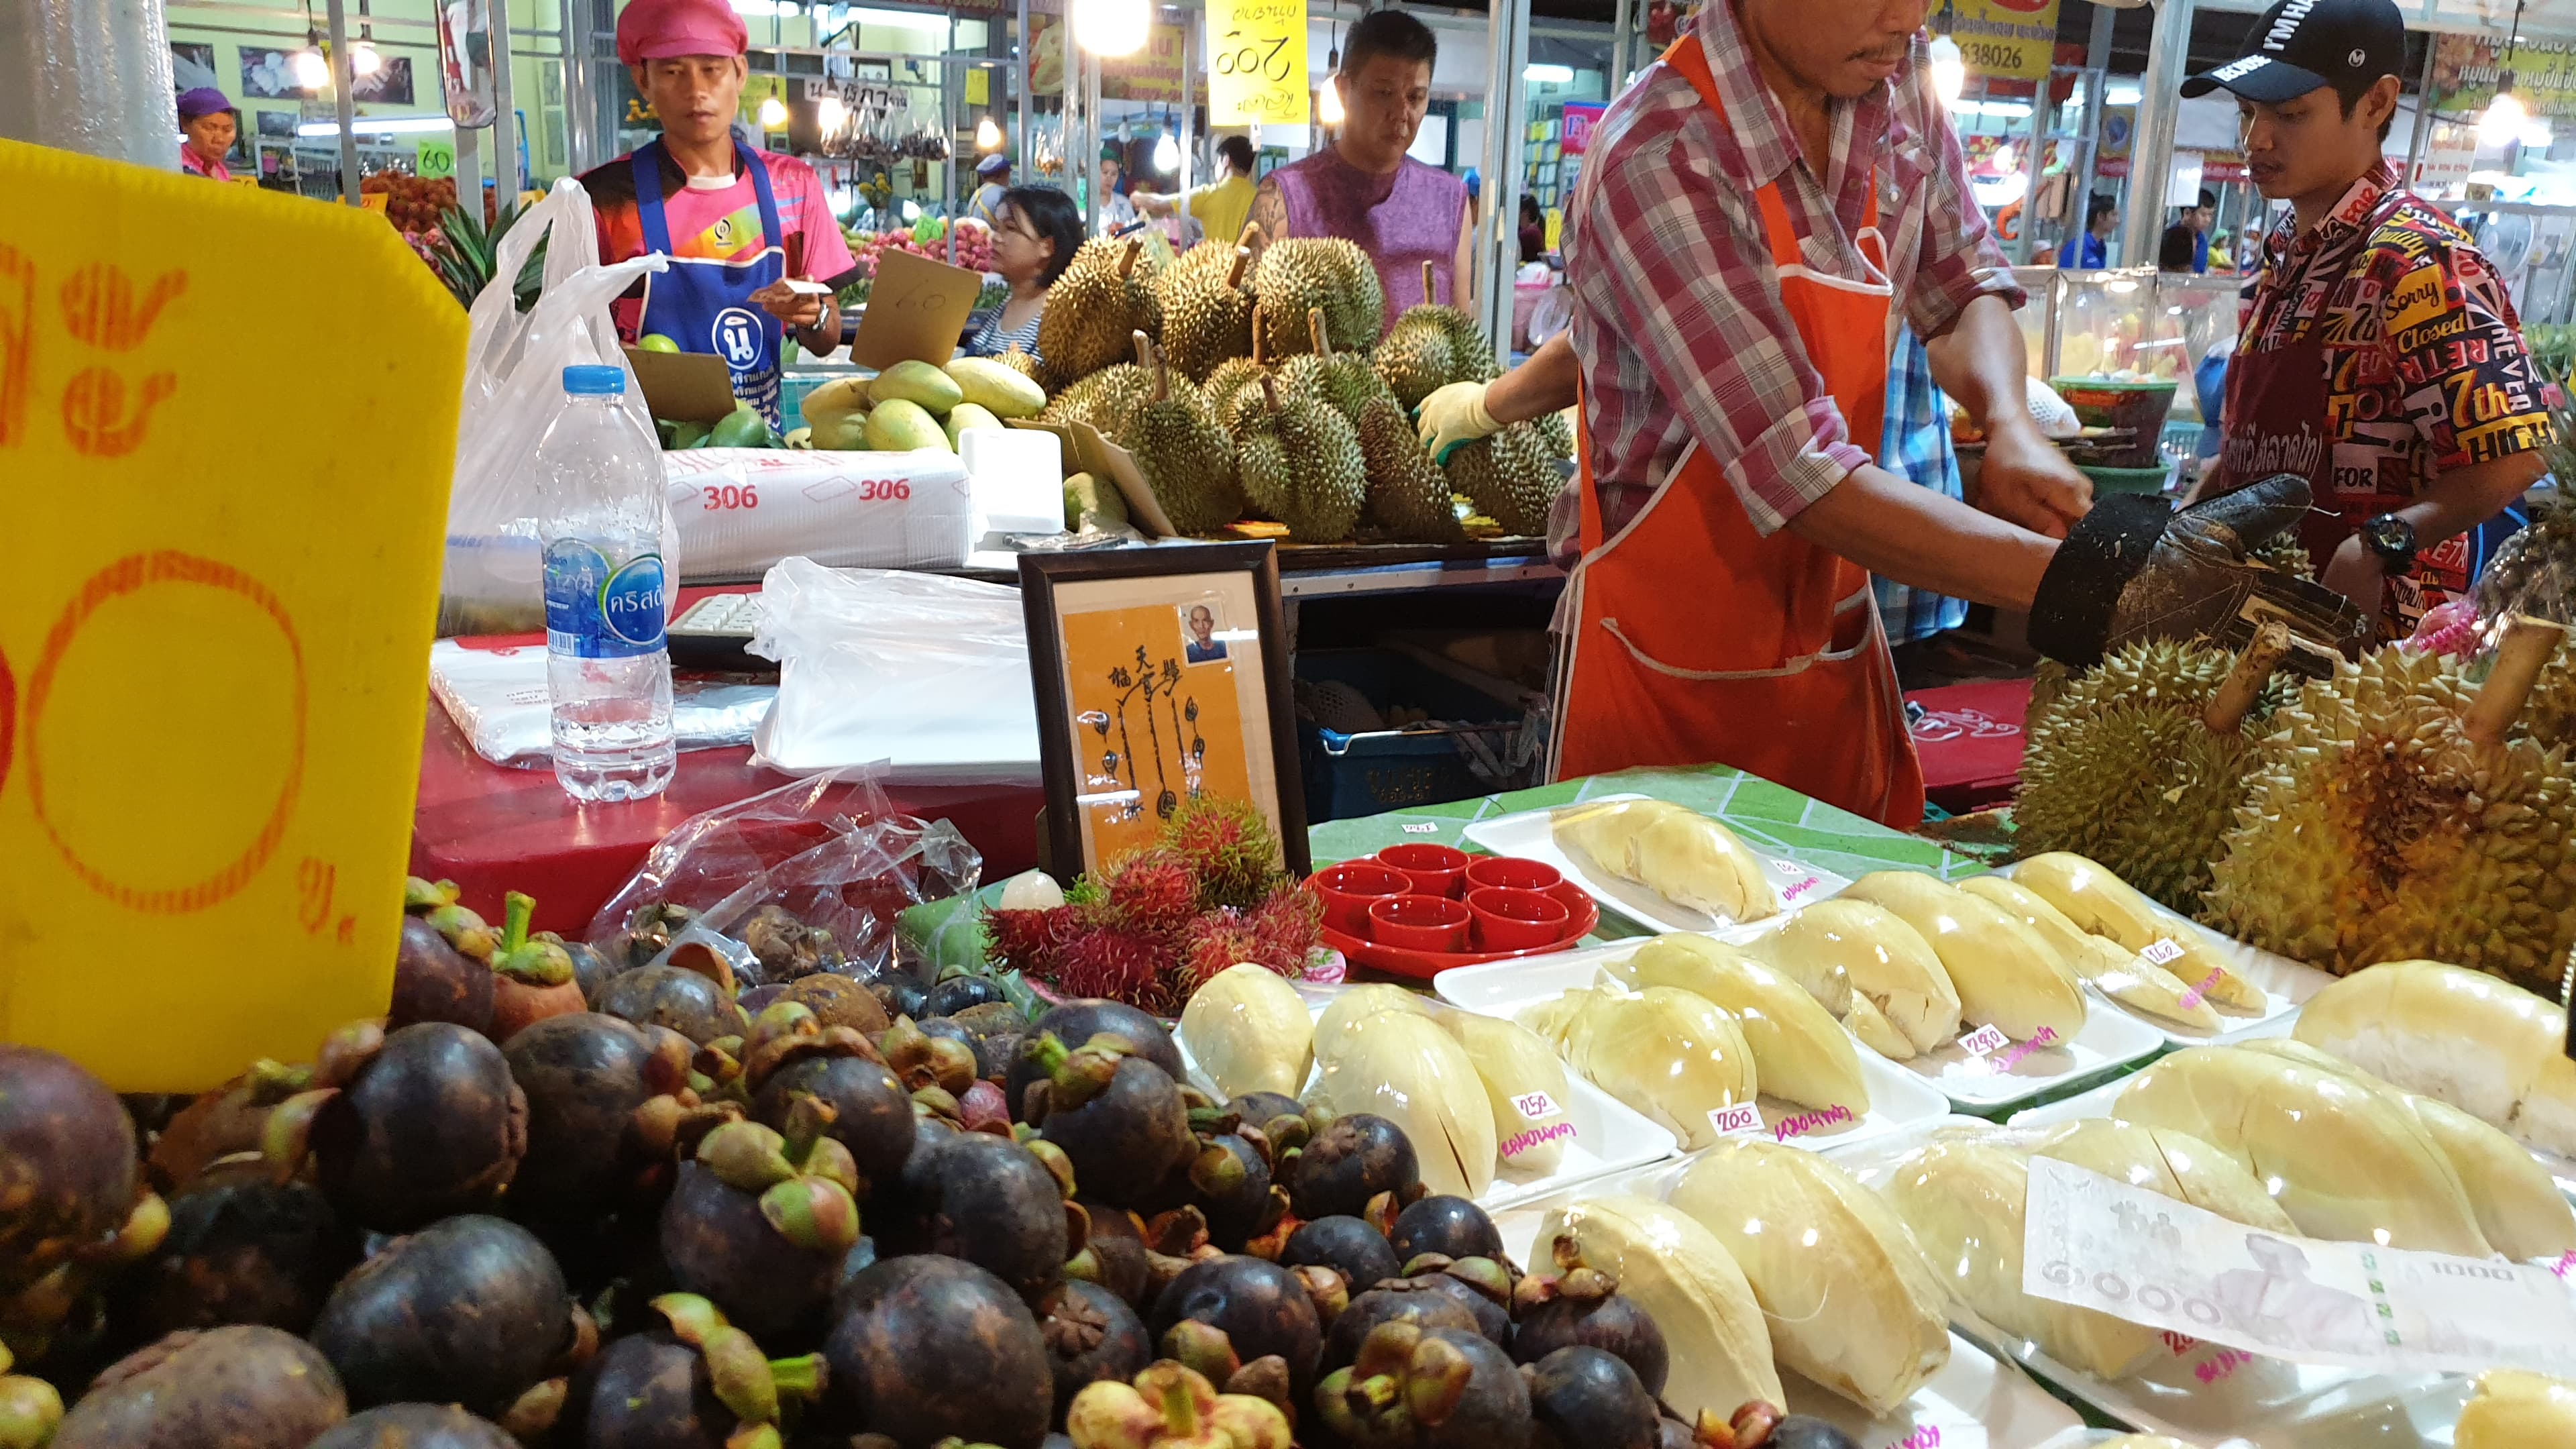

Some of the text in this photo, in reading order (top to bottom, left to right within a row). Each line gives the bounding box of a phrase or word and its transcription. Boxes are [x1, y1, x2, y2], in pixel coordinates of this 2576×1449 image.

[423, 149, 451, 173] 60
[2385, 281, 2440, 321] Sorry
[2398, 313, 2465, 354] Closed
[2491, 329, 2532, 412] NEVER
[2445, 369, 2512, 429] 7th
[2334, 467, 2373, 488] FOR
[703, 477, 911, 511] 306 306
[610, 584, 665, 614] คริสตั
[1519, 1095, 1548, 1116] 250
[1716, 1110, 1752, 1132] 200
